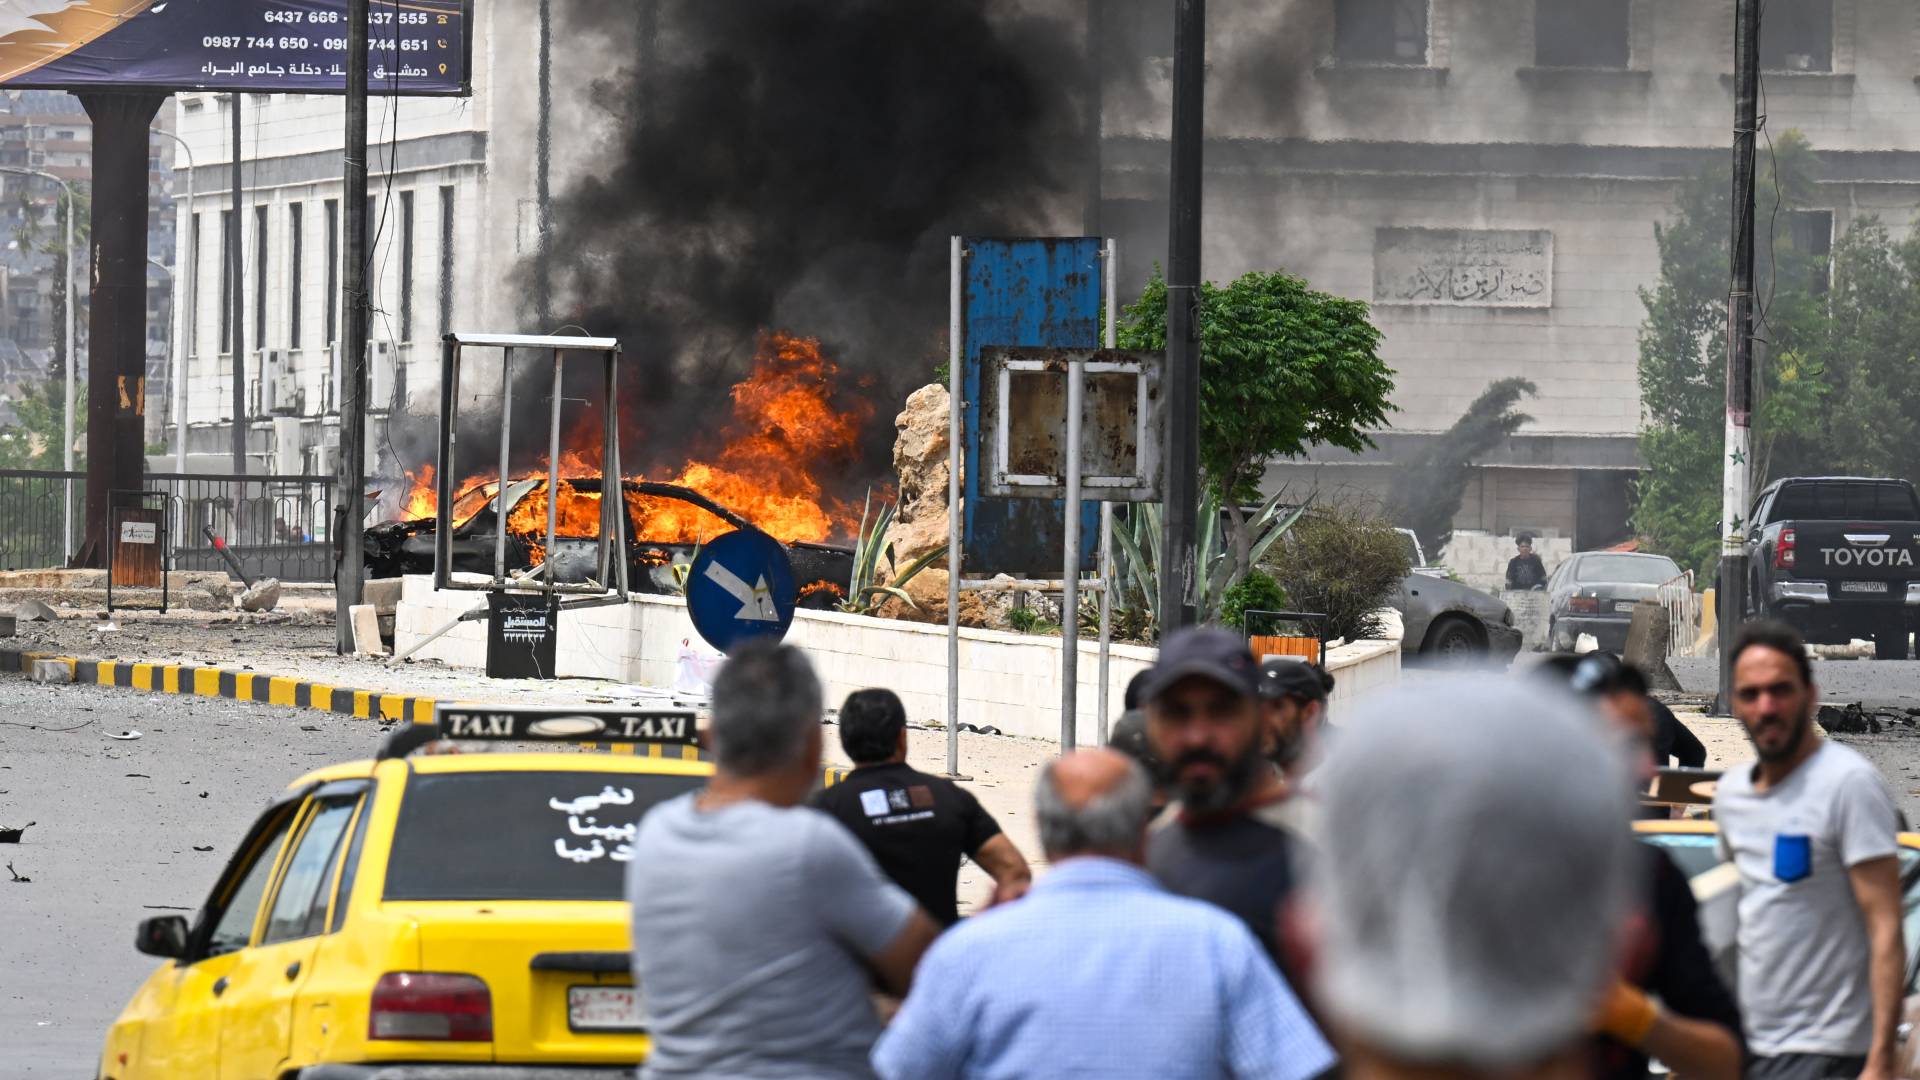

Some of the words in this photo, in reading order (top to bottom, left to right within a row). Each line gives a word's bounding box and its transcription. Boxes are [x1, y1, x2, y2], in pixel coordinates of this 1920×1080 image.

[264, 11, 303, 23] 6437
[308, 11, 338, 23] 666
[398, 12, 428, 24] 555
[202, 36, 241, 48] 0987
[246, 37, 274, 48] 744
[279, 37, 309, 49] 650
[367, 39, 396, 50] 744
[400, 39, 428, 51] 651
[201, 61, 244, 76] البراء
[248, 62, 285, 77] جامع
[289, 63, 321, 75] دخلة
[373, 63, 428, 79] دمشق
[1820, 548, 1914, 566] TOYOTA
[503, 615, 546, 629] المستقبل
[448, 714, 515, 737] TAXI
[620, 716, 687, 738] TAXI
